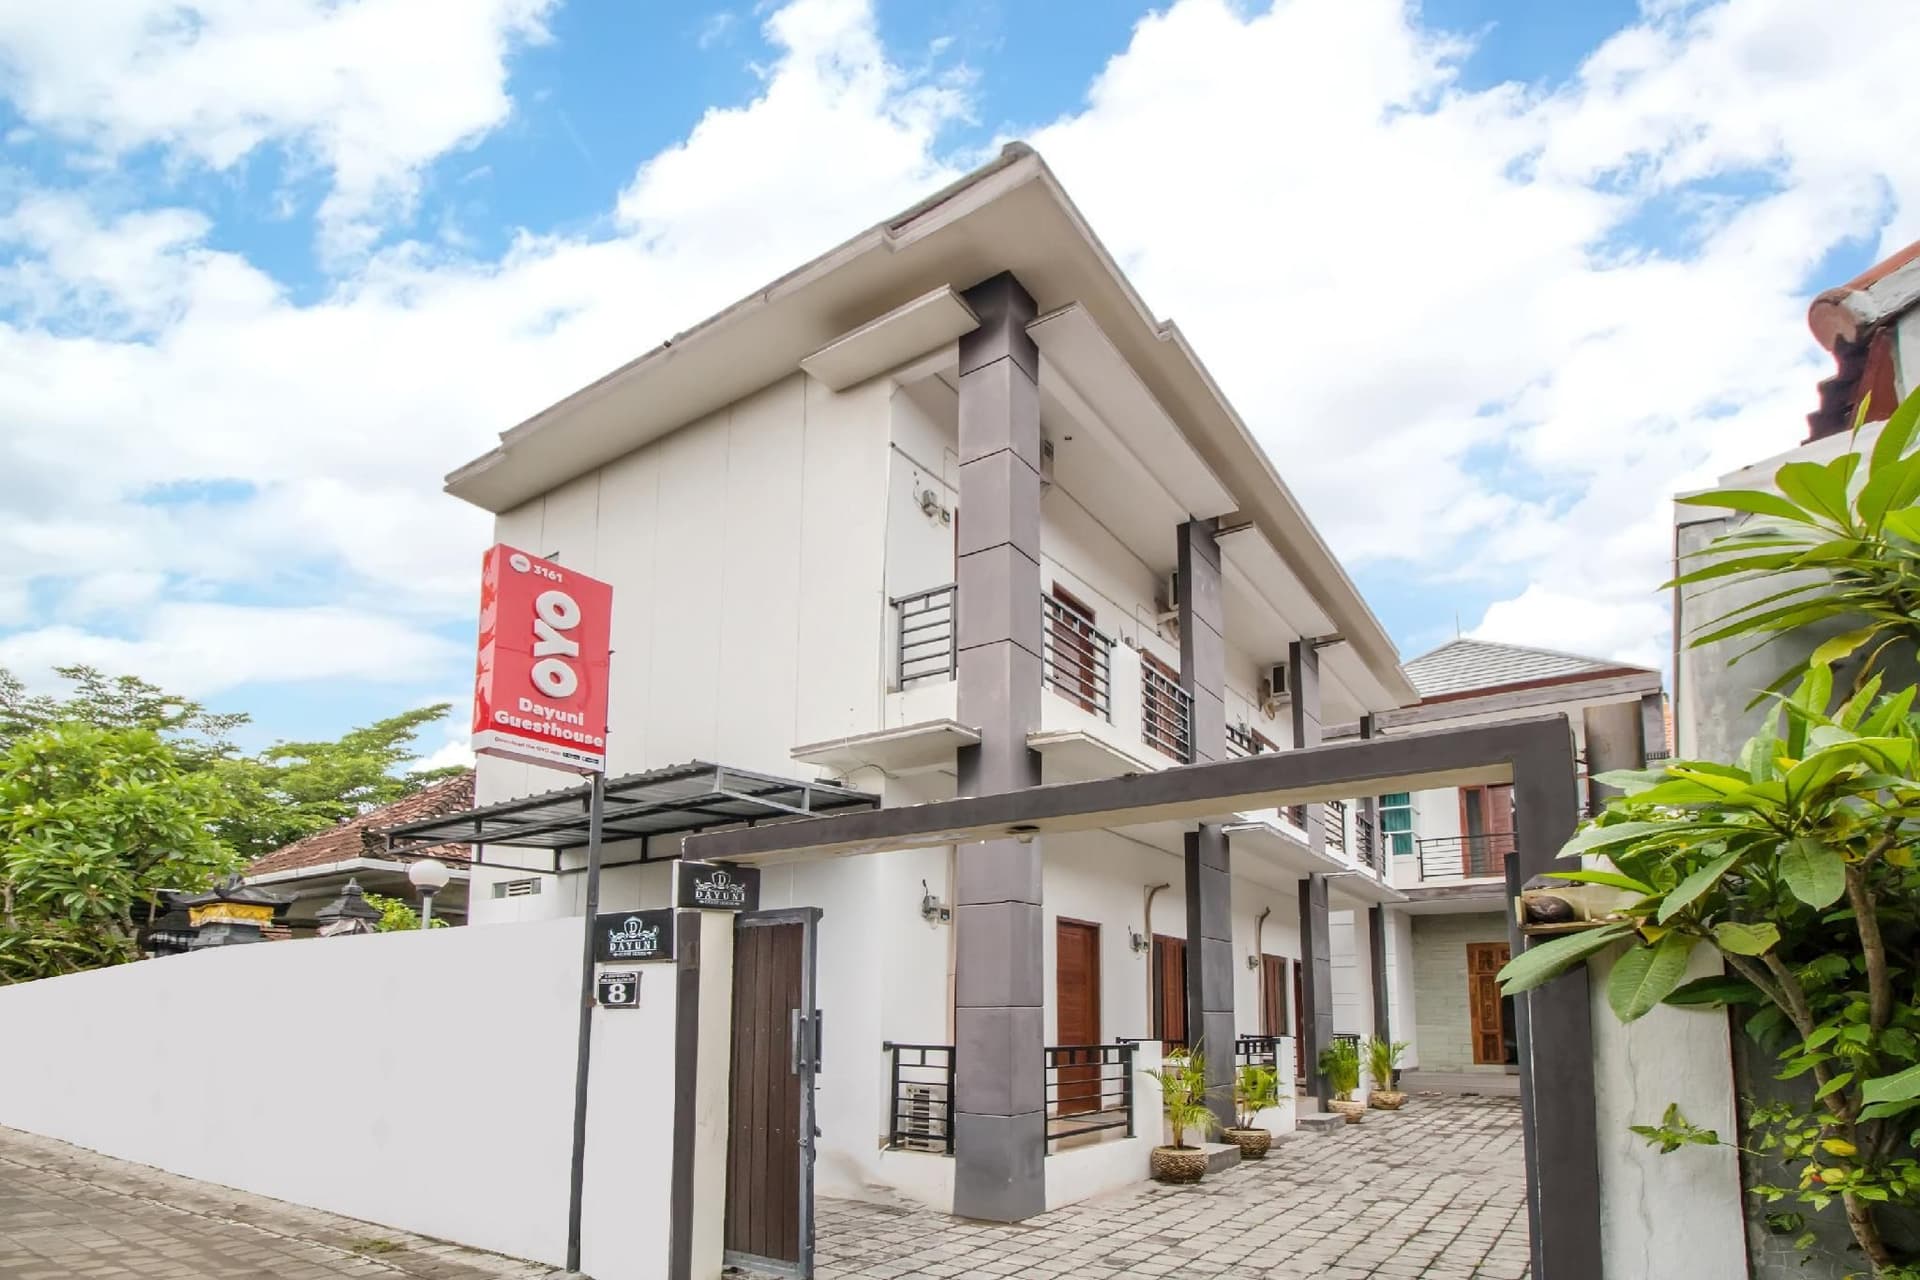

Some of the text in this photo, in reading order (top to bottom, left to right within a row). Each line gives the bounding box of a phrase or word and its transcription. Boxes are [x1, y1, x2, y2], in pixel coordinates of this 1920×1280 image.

[533, 564, 563, 583] 3161
[531, 590, 581, 698] OYO
[518, 697, 585, 727] Dayuni
[494, 710, 604, 747] Guesthouse
[695, 889, 745, 902] DAYUNI
[609, 940, 657, 952] DAYUNI
[608, 983, 627, 1003] 8
